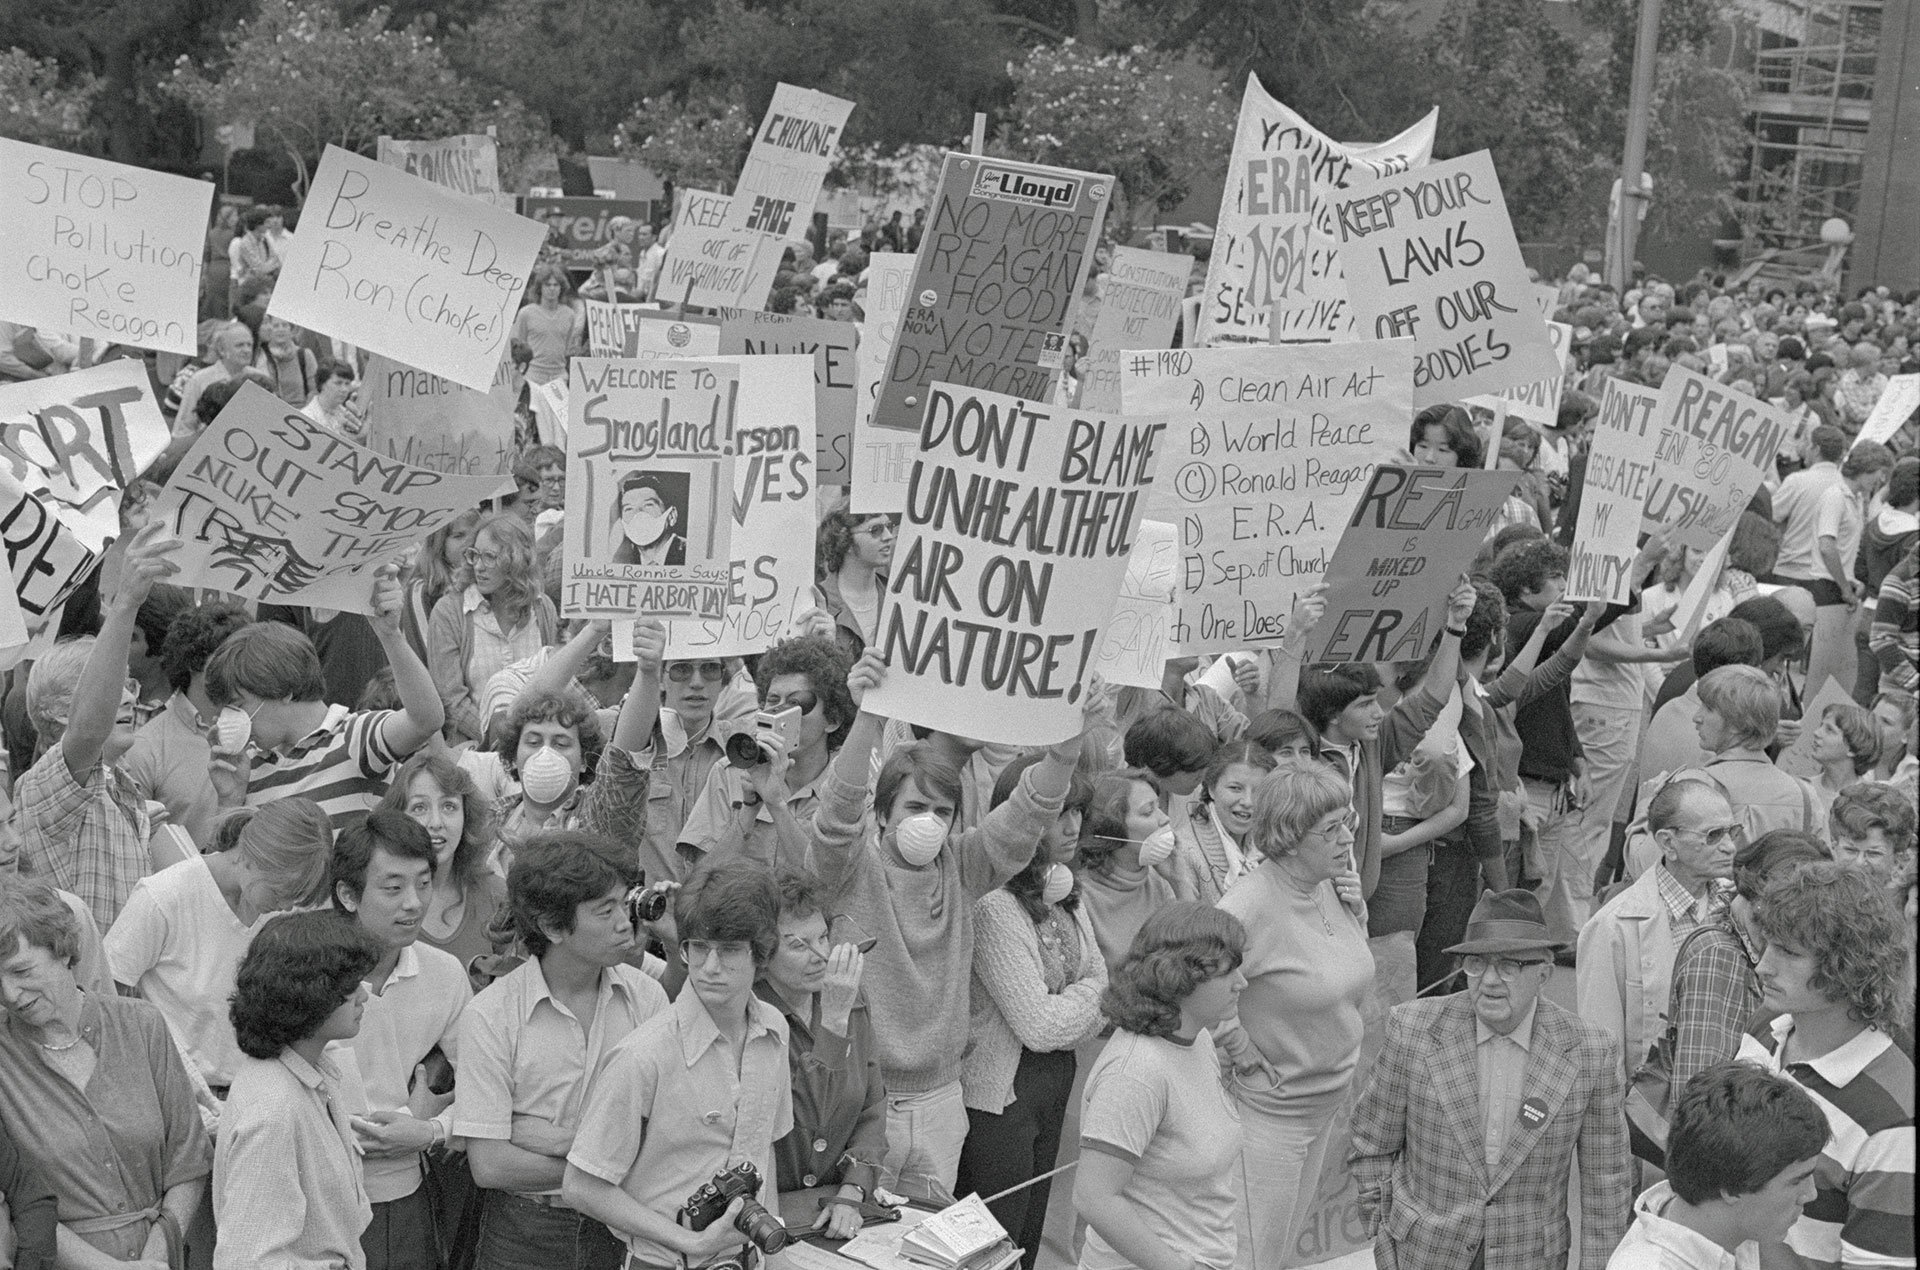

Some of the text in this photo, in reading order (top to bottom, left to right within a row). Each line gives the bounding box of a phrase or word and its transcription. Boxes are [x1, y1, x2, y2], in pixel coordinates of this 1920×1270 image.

[763, 113, 838, 158] CHOKING
[25, 161, 138, 209] STOP
[999, 173, 1075, 206] Lloyd
[1248, 154, 1312, 217] ERA
[1336, 189, 1401, 243] KEEP
[1403, 172, 1491, 221] YOUR
[746, 195, 797, 235] SMOG
[933, 194, 1094, 254] NO MORE
[702, 239, 751, 261] OUT OF
[929, 233, 1083, 294] REAGAN
[1244, 222, 1313, 309] NOW
[1378, 220, 1486, 287] LAWS
[313, 240, 394, 312] Ron
[69, 297, 184, 344] Reagan
[720, 306, 794, 325] NOT REGAN
[906, 307, 935, 322] ERA
[946, 275, 1072, 327] HOOD!
[1102, 283, 1179, 320] PROTECTION
[1375, 305, 1421, 342] OFF
[1435, 280, 1518, 332] OUR
[902, 320, 939, 336] NOW
[939, 317, 1046, 365] VOTE
[1121, 316, 1149, 336] NOT
[577, 361, 718, 393] WELCOME TO
[1130, 351, 1193, 377] #1980
[1413, 329, 1512, 388] BODIES
[1190, 365, 1385, 411] A) Clean Air Act
[1601, 380, 1658, 437] DON'T
[577, 380, 740, 462] Smogland!
[736, 425, 801, 457] rson
[919, 389, 1051, 473] DON'T
[1060, 419, 1168, 488] BLAME
[1190, 413, 1374, 457] B) World Peace
[1671, 378, 1789, 473] REAGAN
[269, 414, 443, 496] STAMP
[866, 442, 917, 484] THE
[1654, 428, 1690, 466] IN
[223, 428, 455, 532] OUT SMOG
[1222, 463, 1296, 496] Ronald
[1305, 458, 1376, 496] Reagan
[1351, 466, 1500, 531] REAGAN
[185, 455, 417, 559] NUKE THE
[906, 459, 1140, 560] UNHEALTHFUL
[1592, 501, 1614, 538] MY
[1642, 477, 1709, 530] USH
[1185, 513, 1204, 549] D)
[1402, 536, 1418, 552] IS
[572, 562, 616, 579] Uncle
[622, 565, 683, 580] Ronnie
[890, 535, 1055, 628] AIR ON
[1185, 553, 1206, 594] E)
[1212, 550, 1256, 596] Sep.
[1277, 545, 1331, 577] Church
[1365, 556, 1427, 577] MIXED
[1371, 579, 1402, 598] UP
[565, 582, 729, 616] I HATE ARBOR DAY
[1201, 604, 1237, 641] One
[882, 602, 1099, 706] NATURE!
[1320, 606, 1431, 664] ERA
